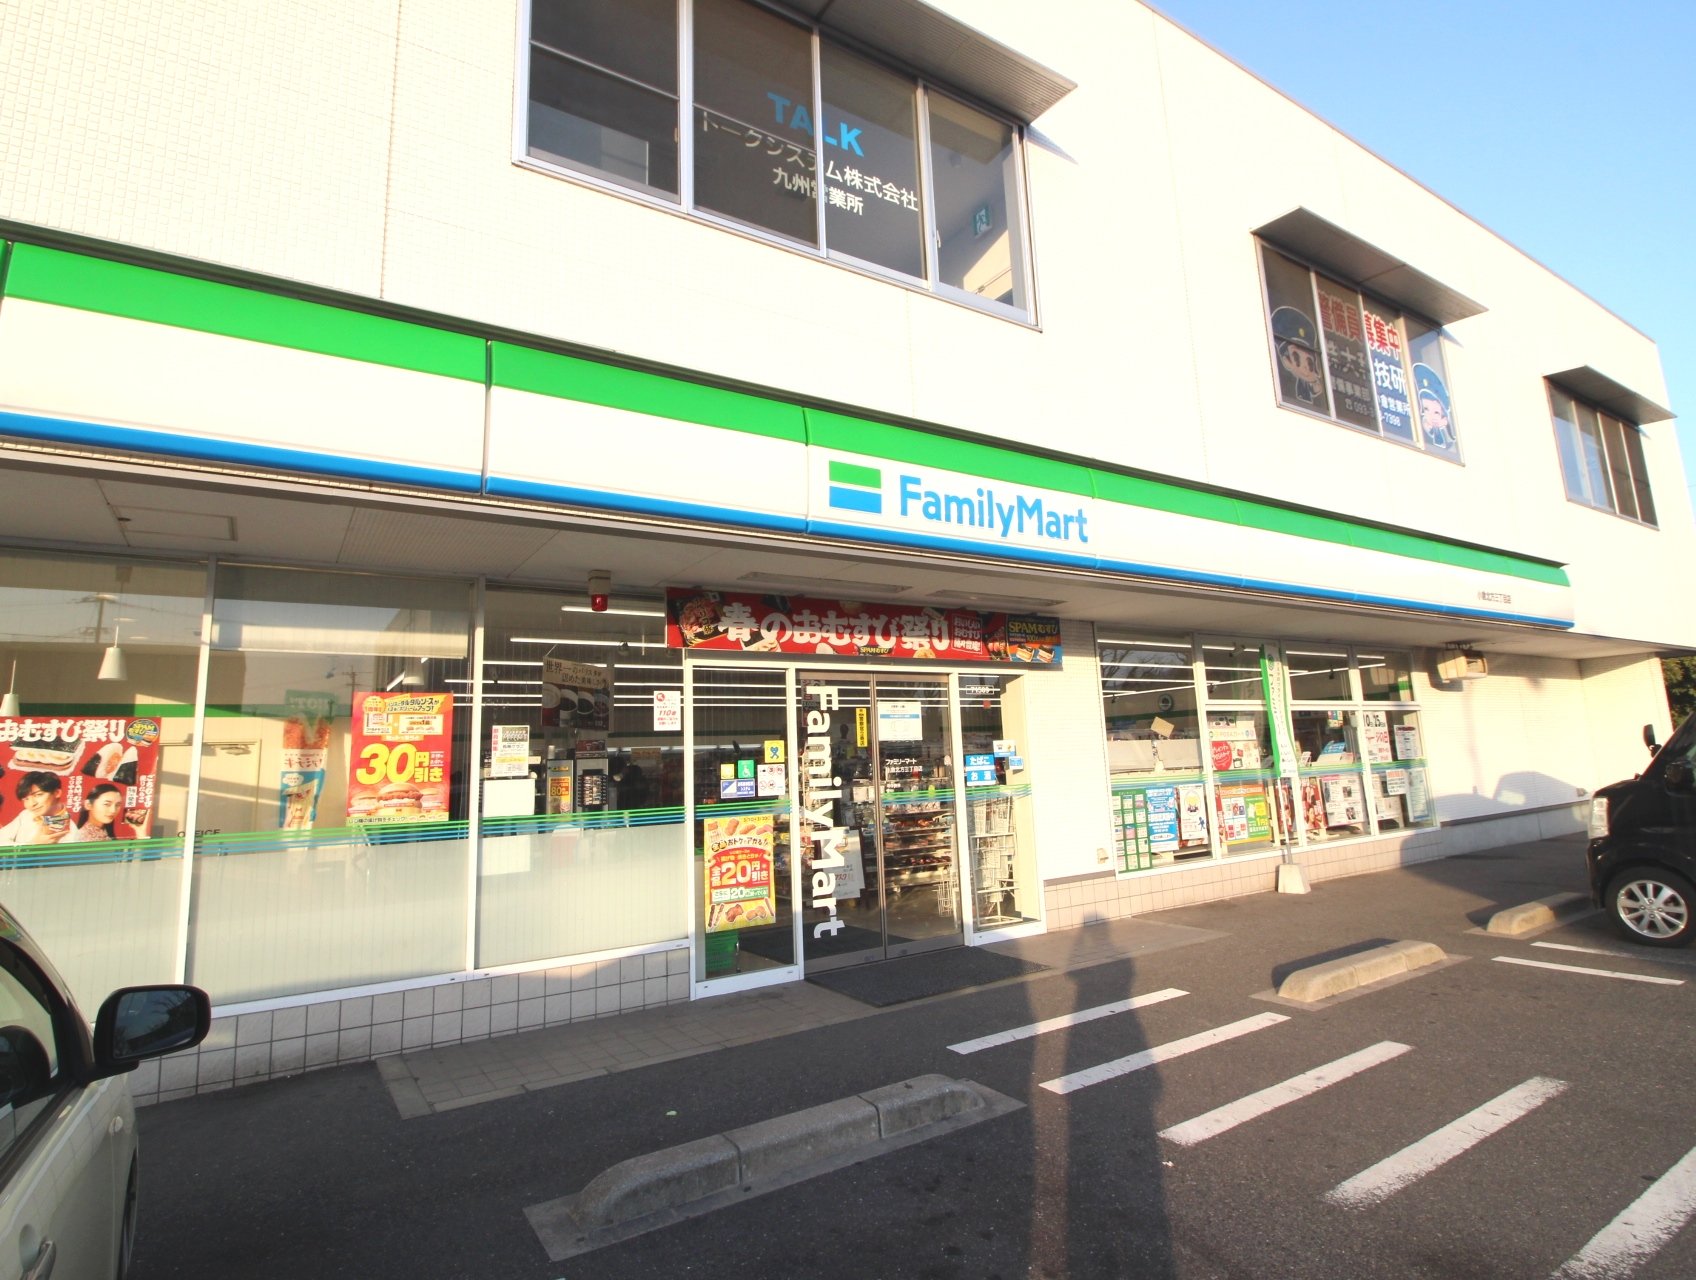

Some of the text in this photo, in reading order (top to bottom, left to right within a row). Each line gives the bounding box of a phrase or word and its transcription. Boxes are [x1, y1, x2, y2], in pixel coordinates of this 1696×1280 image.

[767, 92, 864, 158] TALK
[900, 474, 1088, 543] FamilyMart
[718, 602, 950, 651] 春のおむすび祭り
[804, 686, 845, 938] FamilyMart
